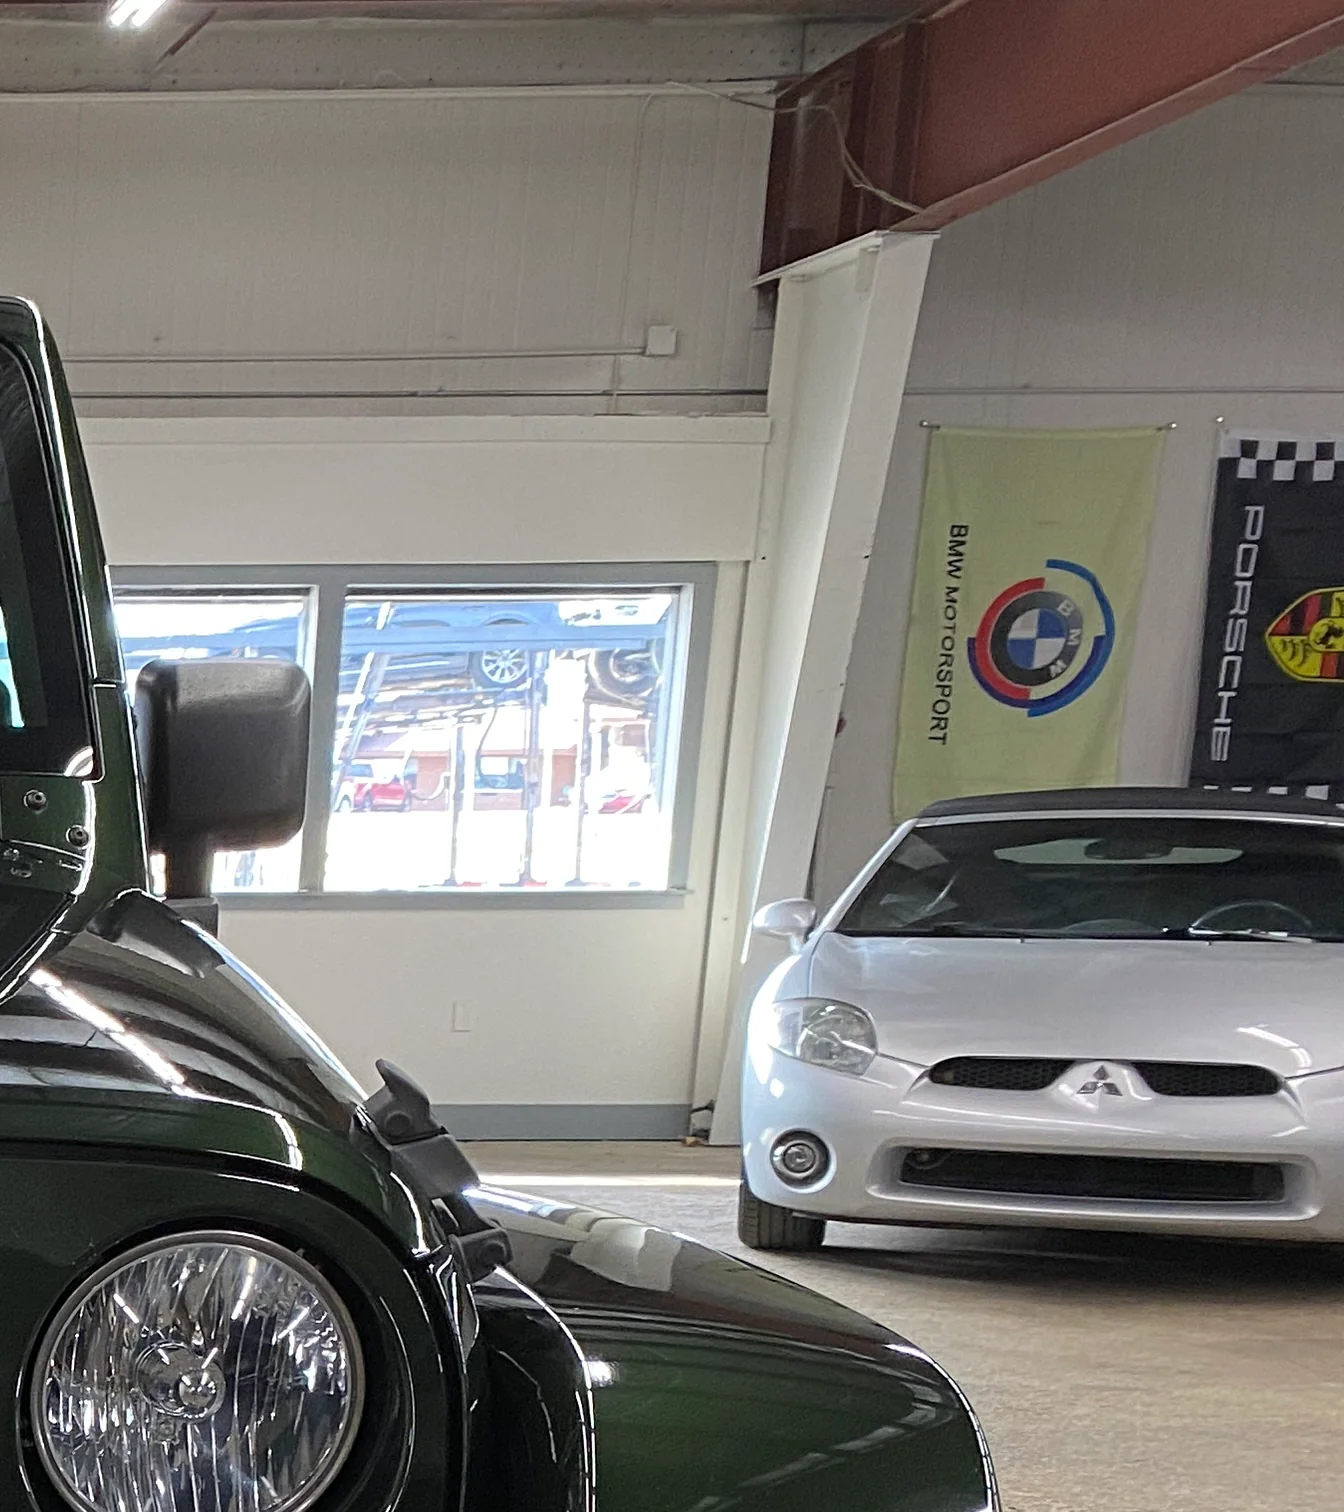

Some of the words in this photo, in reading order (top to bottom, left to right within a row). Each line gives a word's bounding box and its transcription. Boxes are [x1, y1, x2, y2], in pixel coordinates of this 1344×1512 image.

[947, 525, 969, 579] BMW
[928, 586, 960, 745] MOTORSPORT
[1211, 505, 1264, 761] PORSCHE
